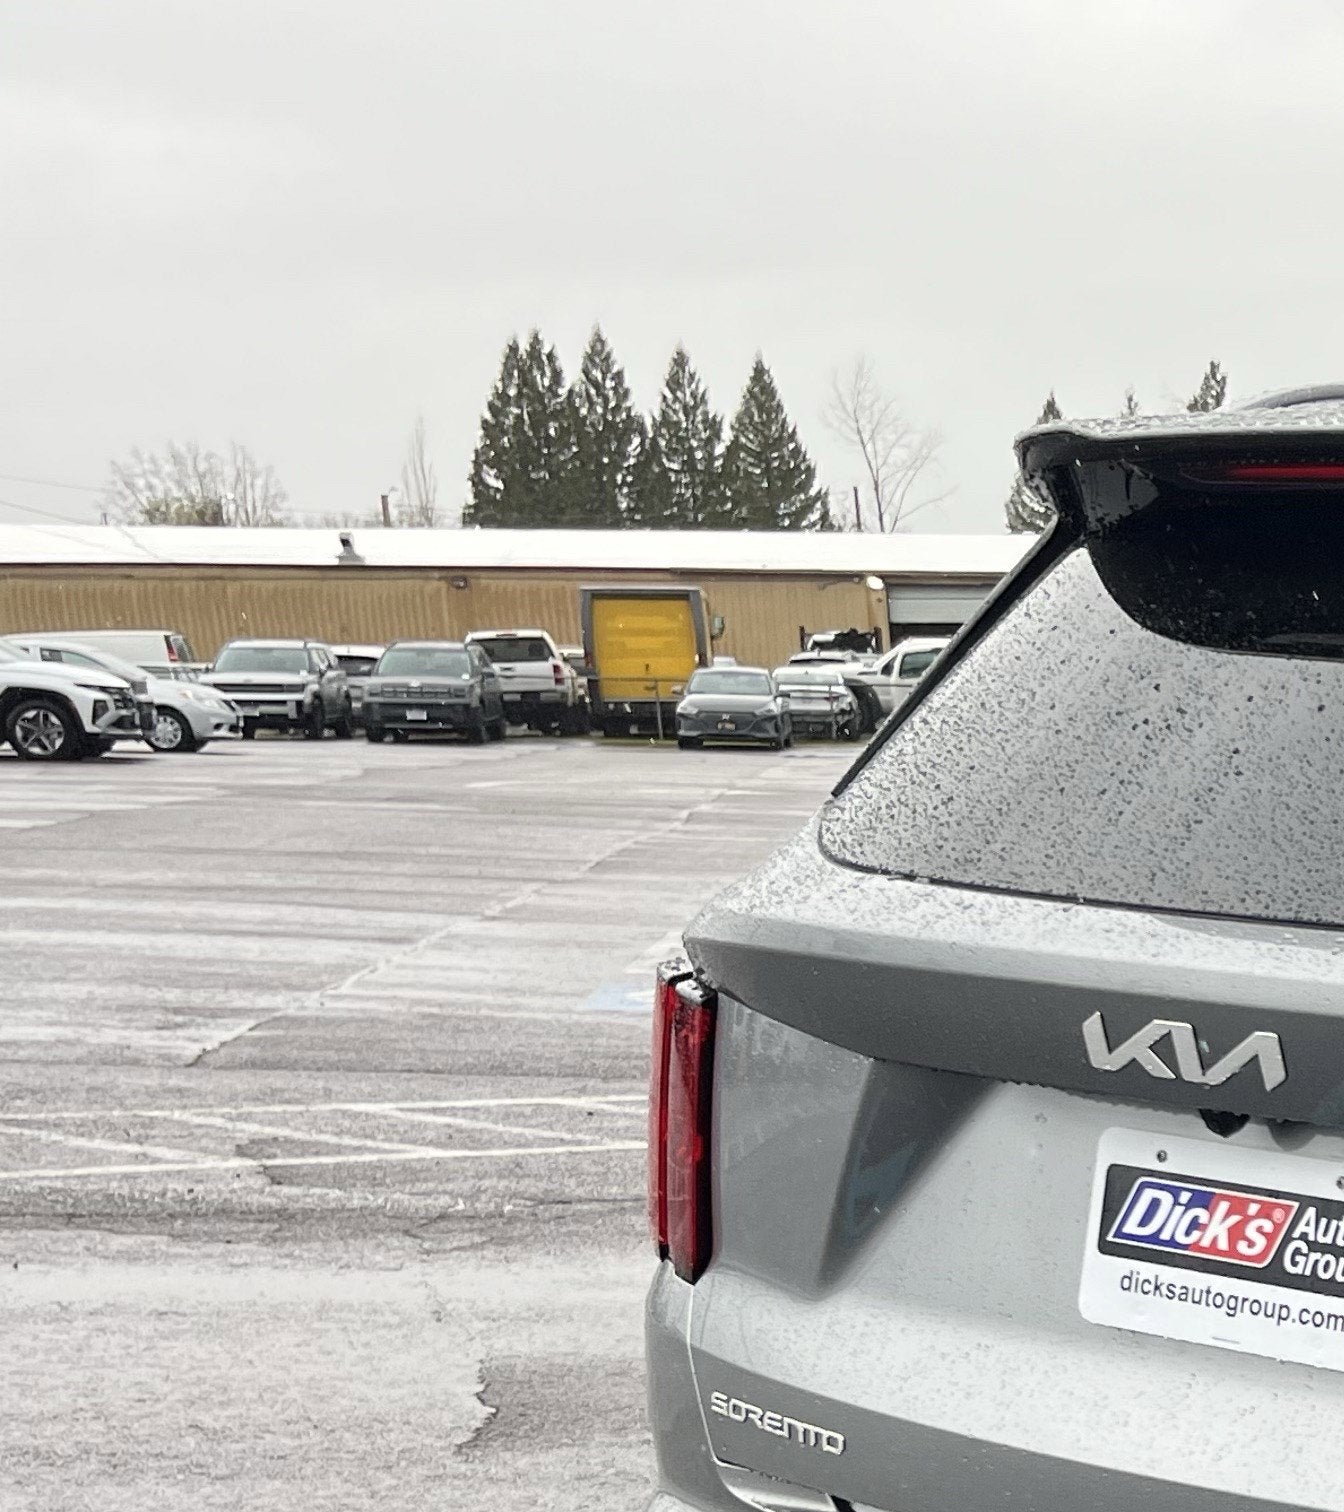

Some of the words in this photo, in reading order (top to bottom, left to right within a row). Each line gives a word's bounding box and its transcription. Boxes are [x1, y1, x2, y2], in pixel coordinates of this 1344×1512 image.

[1082, 1011, 1288, 1092] KIA
[1123, 1188, 1274, 1257] Dick's
[711, 1391, 844, 1455] SORENTO
